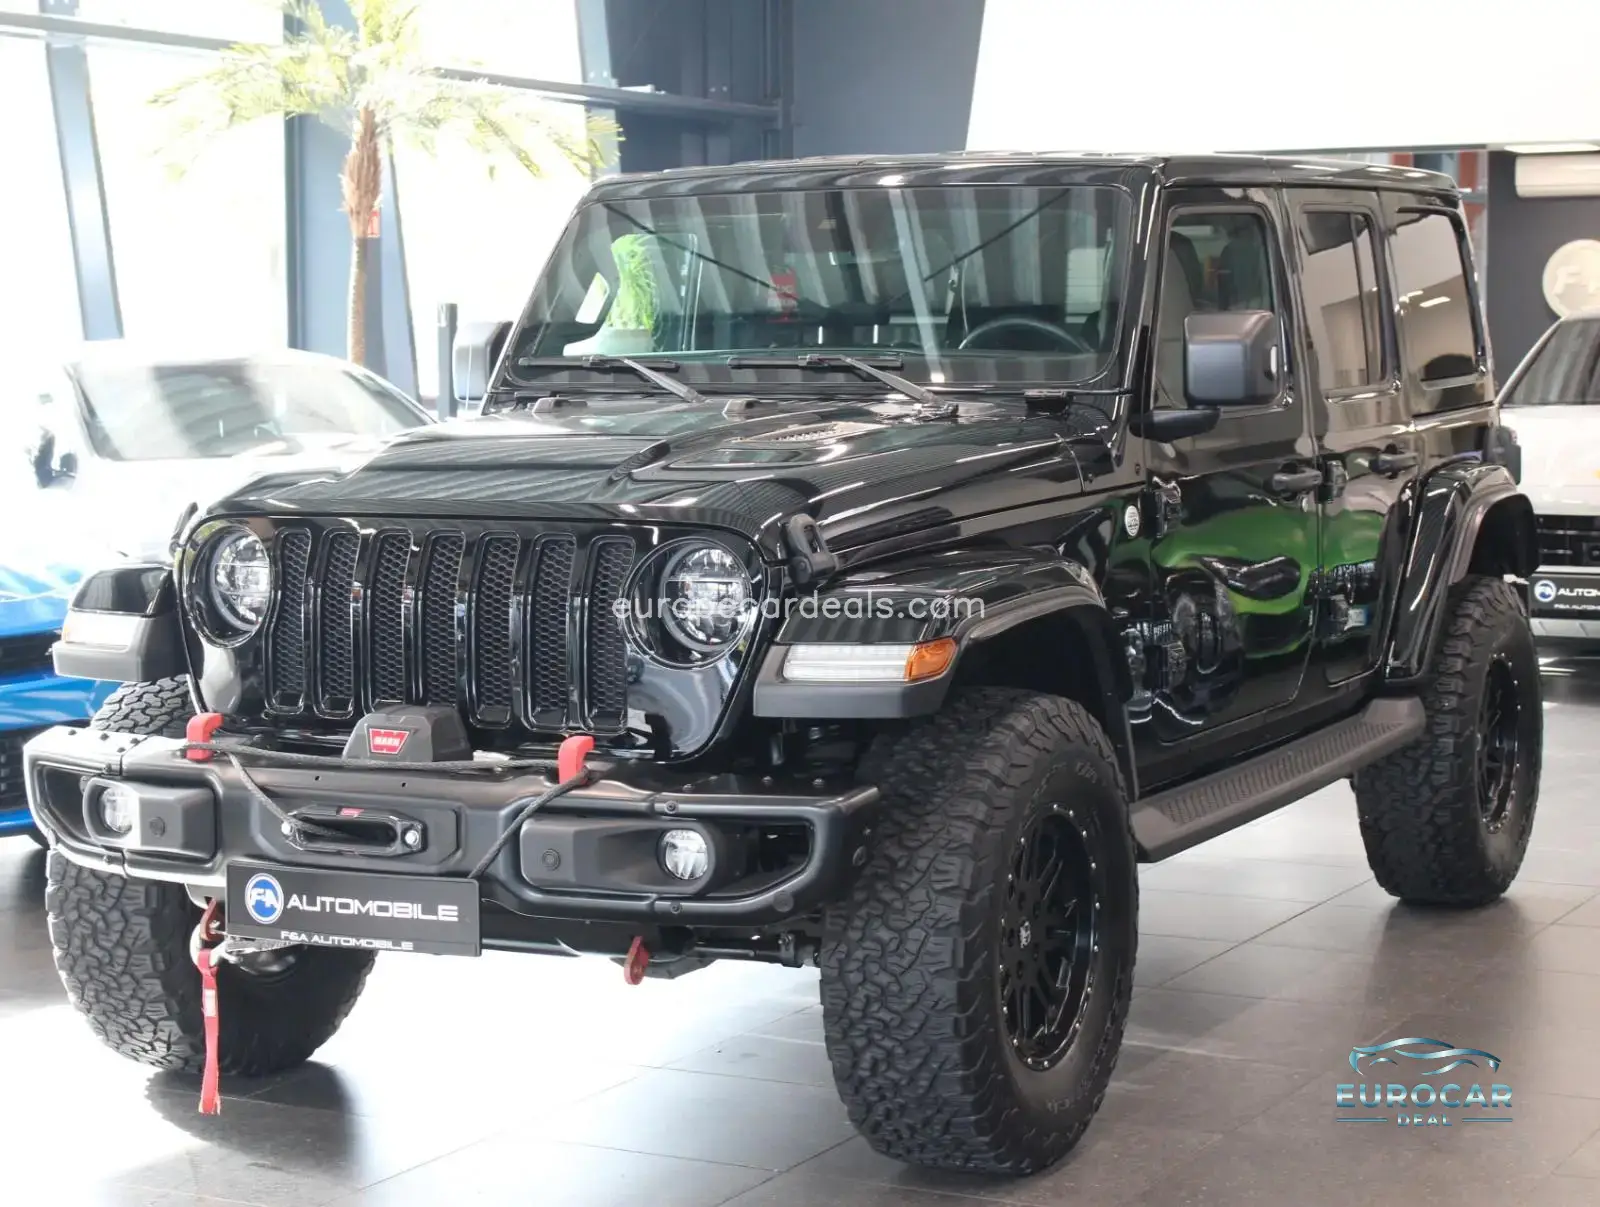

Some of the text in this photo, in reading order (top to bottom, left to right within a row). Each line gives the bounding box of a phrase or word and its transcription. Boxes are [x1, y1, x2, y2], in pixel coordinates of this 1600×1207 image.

[286, 893, 459, 922] AUTOMOBILE
[280, 930, 414, 951] F&A AUTOMOBILE
